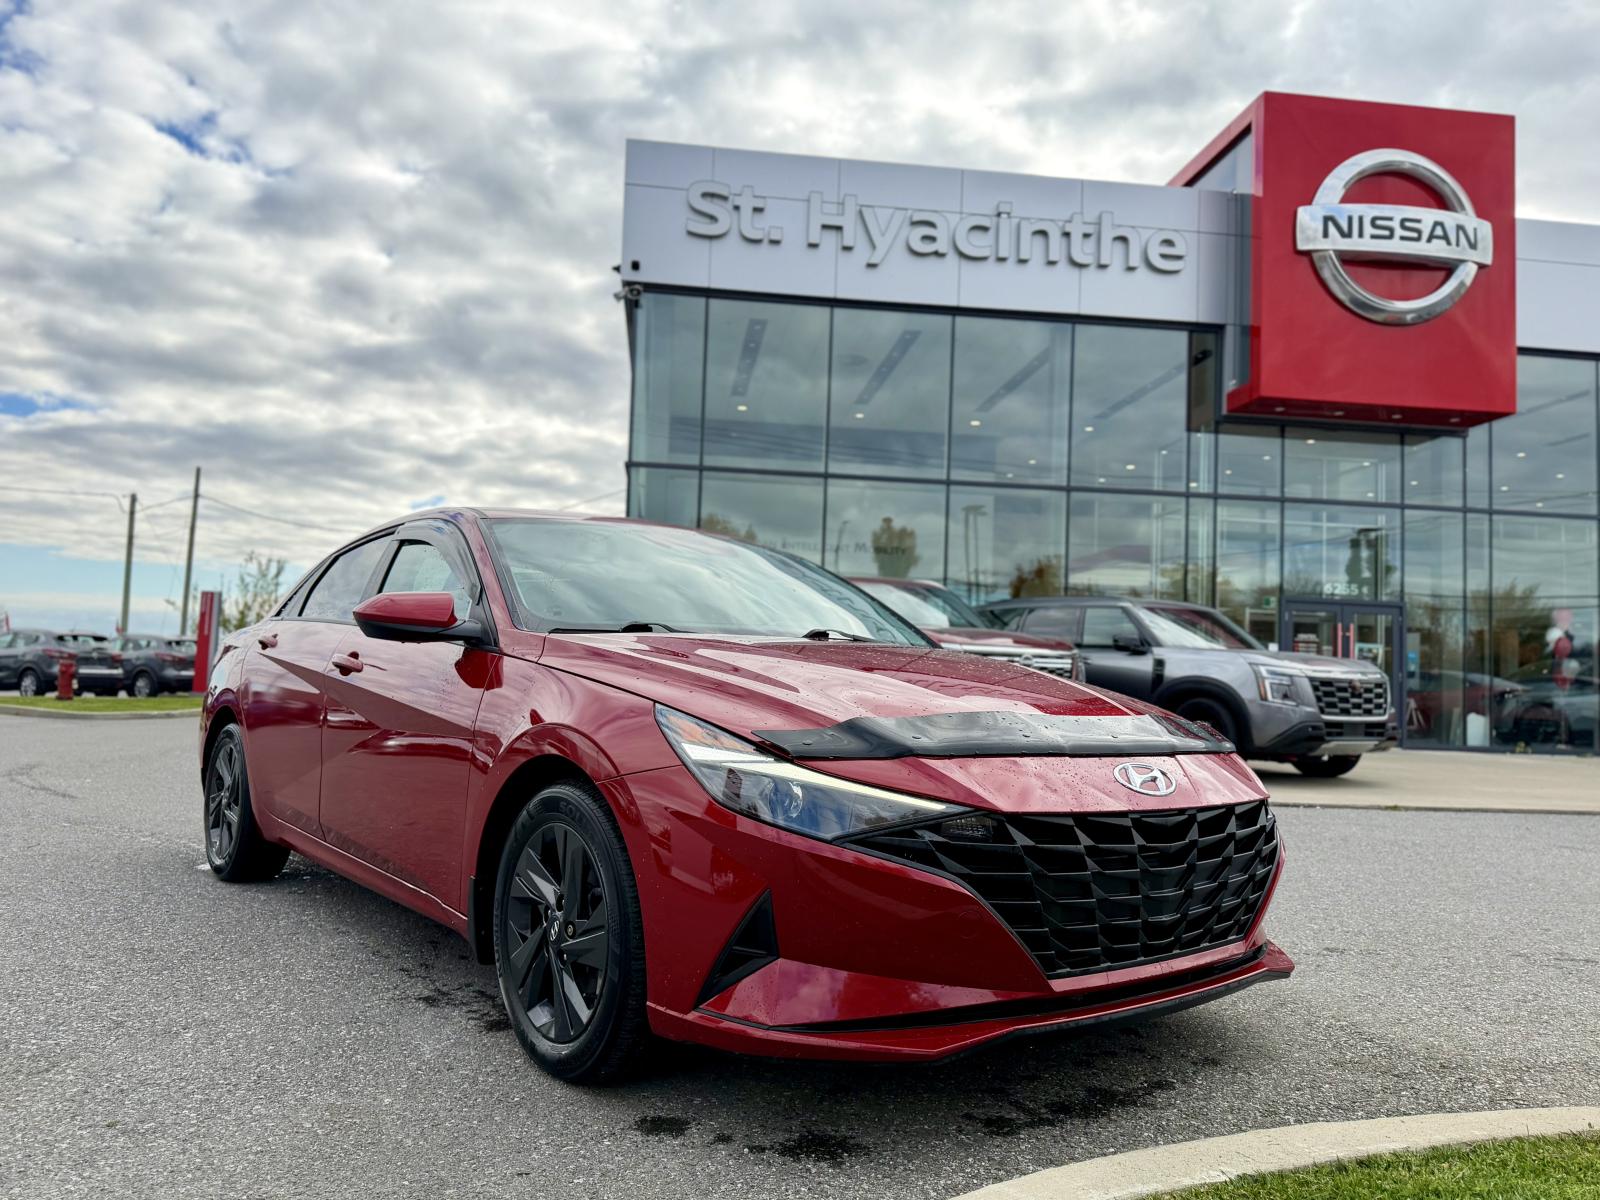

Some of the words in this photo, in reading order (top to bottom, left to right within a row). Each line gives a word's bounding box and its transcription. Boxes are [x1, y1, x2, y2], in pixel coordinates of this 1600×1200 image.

[685, 180, 783, 245] St.
[807, 189, 1188, 273] Hyacinthe
[1322, 214, 1478, 251] NISSAN
[1323, 583, 1359, 596] 6255
